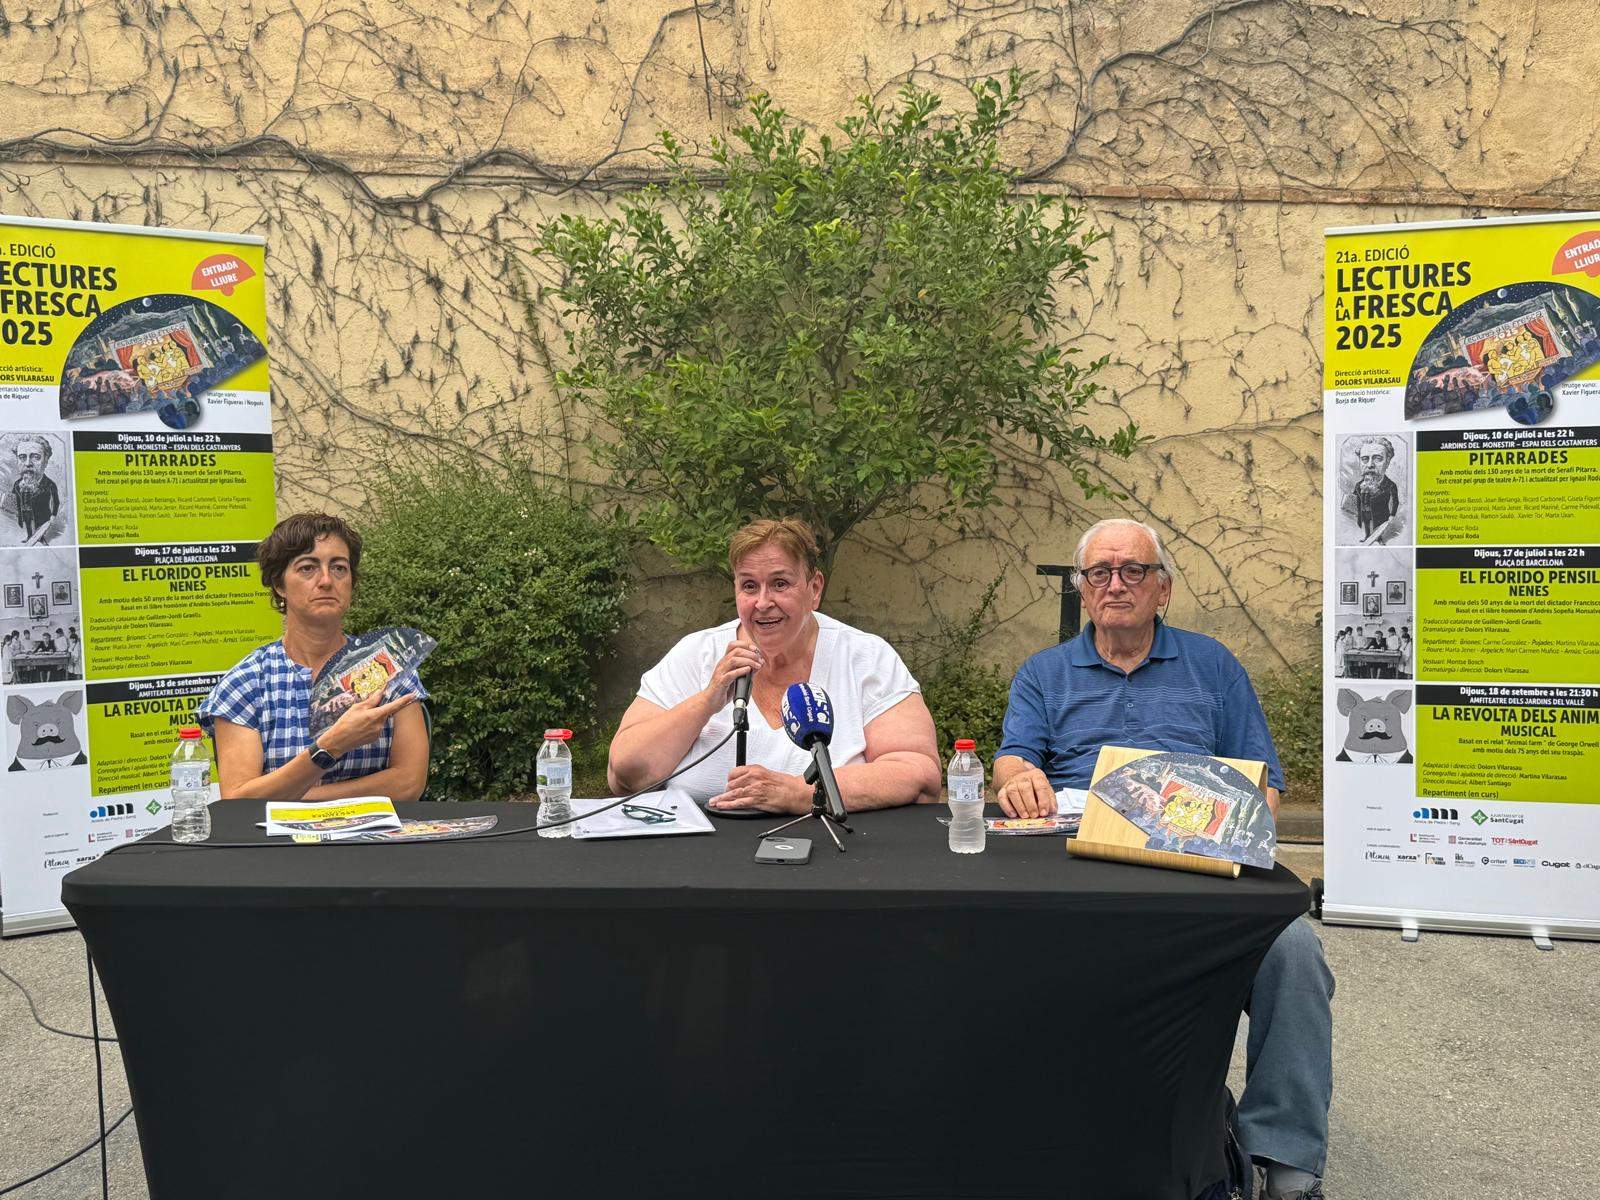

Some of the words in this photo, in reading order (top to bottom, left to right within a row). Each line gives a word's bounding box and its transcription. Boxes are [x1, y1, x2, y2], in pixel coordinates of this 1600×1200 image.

[10, 243, 55, 258] EDICIÓ
[1336, 250, 1361, 263] 21a.
[1365, 244, 1409, 261] EDICIÓ
[1564, 239, 1600, 259] ENTRAD
[1574, 253, 1600, 270] LLIUR
[202, 261, 239, 277] ENTRADA
[0, 261, 118, 291] ECTURES
[211, 273, 238, 287] LLIURE
[1337, 261, 1471, 292] LECTURES
[1, 289, 101, 317] FRESCA
[1336, 296, 1344, 308] A
[1353, 291, 1452, 319] FRESCA
[1336, 309, 1350, 321] LA
[2, 319, 52, 345] 025
[1336, 323, 1402, 350] 2025
[16, 374, 54, 382] VILARASAU
[1335, 369, 1361, 377] Direcció
[1363, 367, 1390, 376] artística:
[1335, 378, 1361, 386] DOLORS
[1362, 376, 1401, 385] VILARASAU
[118, 434, 143, 442] Dijous,
[145, 434, 154, 442] 10
[156, 434, 165, 442] de
[166, 434, 186, 443] juliol
[1463, 432, 1490, 441] Dijous,
[1503, 431, 1513, 439] de
[1514, 430, 1536, 440] juliol
[1543, 430, 1555, 438] les
[1557, 430, 1567, 438] 22
[1440, 442, 1467, 450] JARDINS
[1482, 441, 1515, 449] MONESTIR
[1557, 439, 1597, 447] CASTANYERS
[125, 454, 216, 467] PITARRADES
[1469, 451, 1568, 466] PITARRADES
[135, 547, 160, 556] Dijous,
[181, 546, 202, 555] juliol
[221, 545, 231, 553] 22
[1474, 549, 1501, 558] Dijous,
[1503, 549, 1512, 557] 17
[1514, 549, 1524, 557] de
[1524, 549, 1546, 558] juliol
[155, 557, 174, 565] PLAÇA
[183, 555, 218, 563] BARCELONA
[1495, 559, 1515, 568] PLAÇA
[123, 569, 138, 581] EL
[142, 566, 200, 581] FLORIDO
[206, 565, 250, 578] PENSIL
[1460, 571, 1476, 584] EL
[1480, 570, 1544, 584] FLORIDO
[1548, 570, 1600, 584] PENSIL
[170, 581, 206, 592] NENES
[1509, 585, 1549, 597] NENES
[129, 681, 154, 690] Dijous,
[156, 680, 165, 688] 18
[167, 679, 176, 687] de
[177, 677, 210, 687] setembre
[139, 689, 173, 698] AMFITEATRE
[1460, 687, 1487, 696] Dijous,
[1489, 687, 1498, 695] 18
[1500, 687, 1510, 695] de
[1511, 688, 1548, 696] setembre
[1556, 689, 1567, 697] les
[1569, 689, 1590, 697] 21:30
[1592, 689, 1598, 697] h
[104, 704, 122, 717] LA
[124, 698, 182, 716] REVOLTA
[1553, 698, 1565, 706] DEL
[1433, 706, 1450, 720] LA
[1454, 707, 1518, 722] REVOLTA
[1521, 708, 1556, 724] DELS
[1560, 709, 1600, 725] ANIM
[1501, 725, 1556, 737] MUSICAL
[98, 783, 141, 795] Repartiment
[142, 781, 153, 790] (en
[1423, 788, 1467, 798] Repartiment
[1468, 789, 1479, 798] (en
[1481, 789, 1499, 799] curs)
[1541, 860, 1570, 868] Cugat
